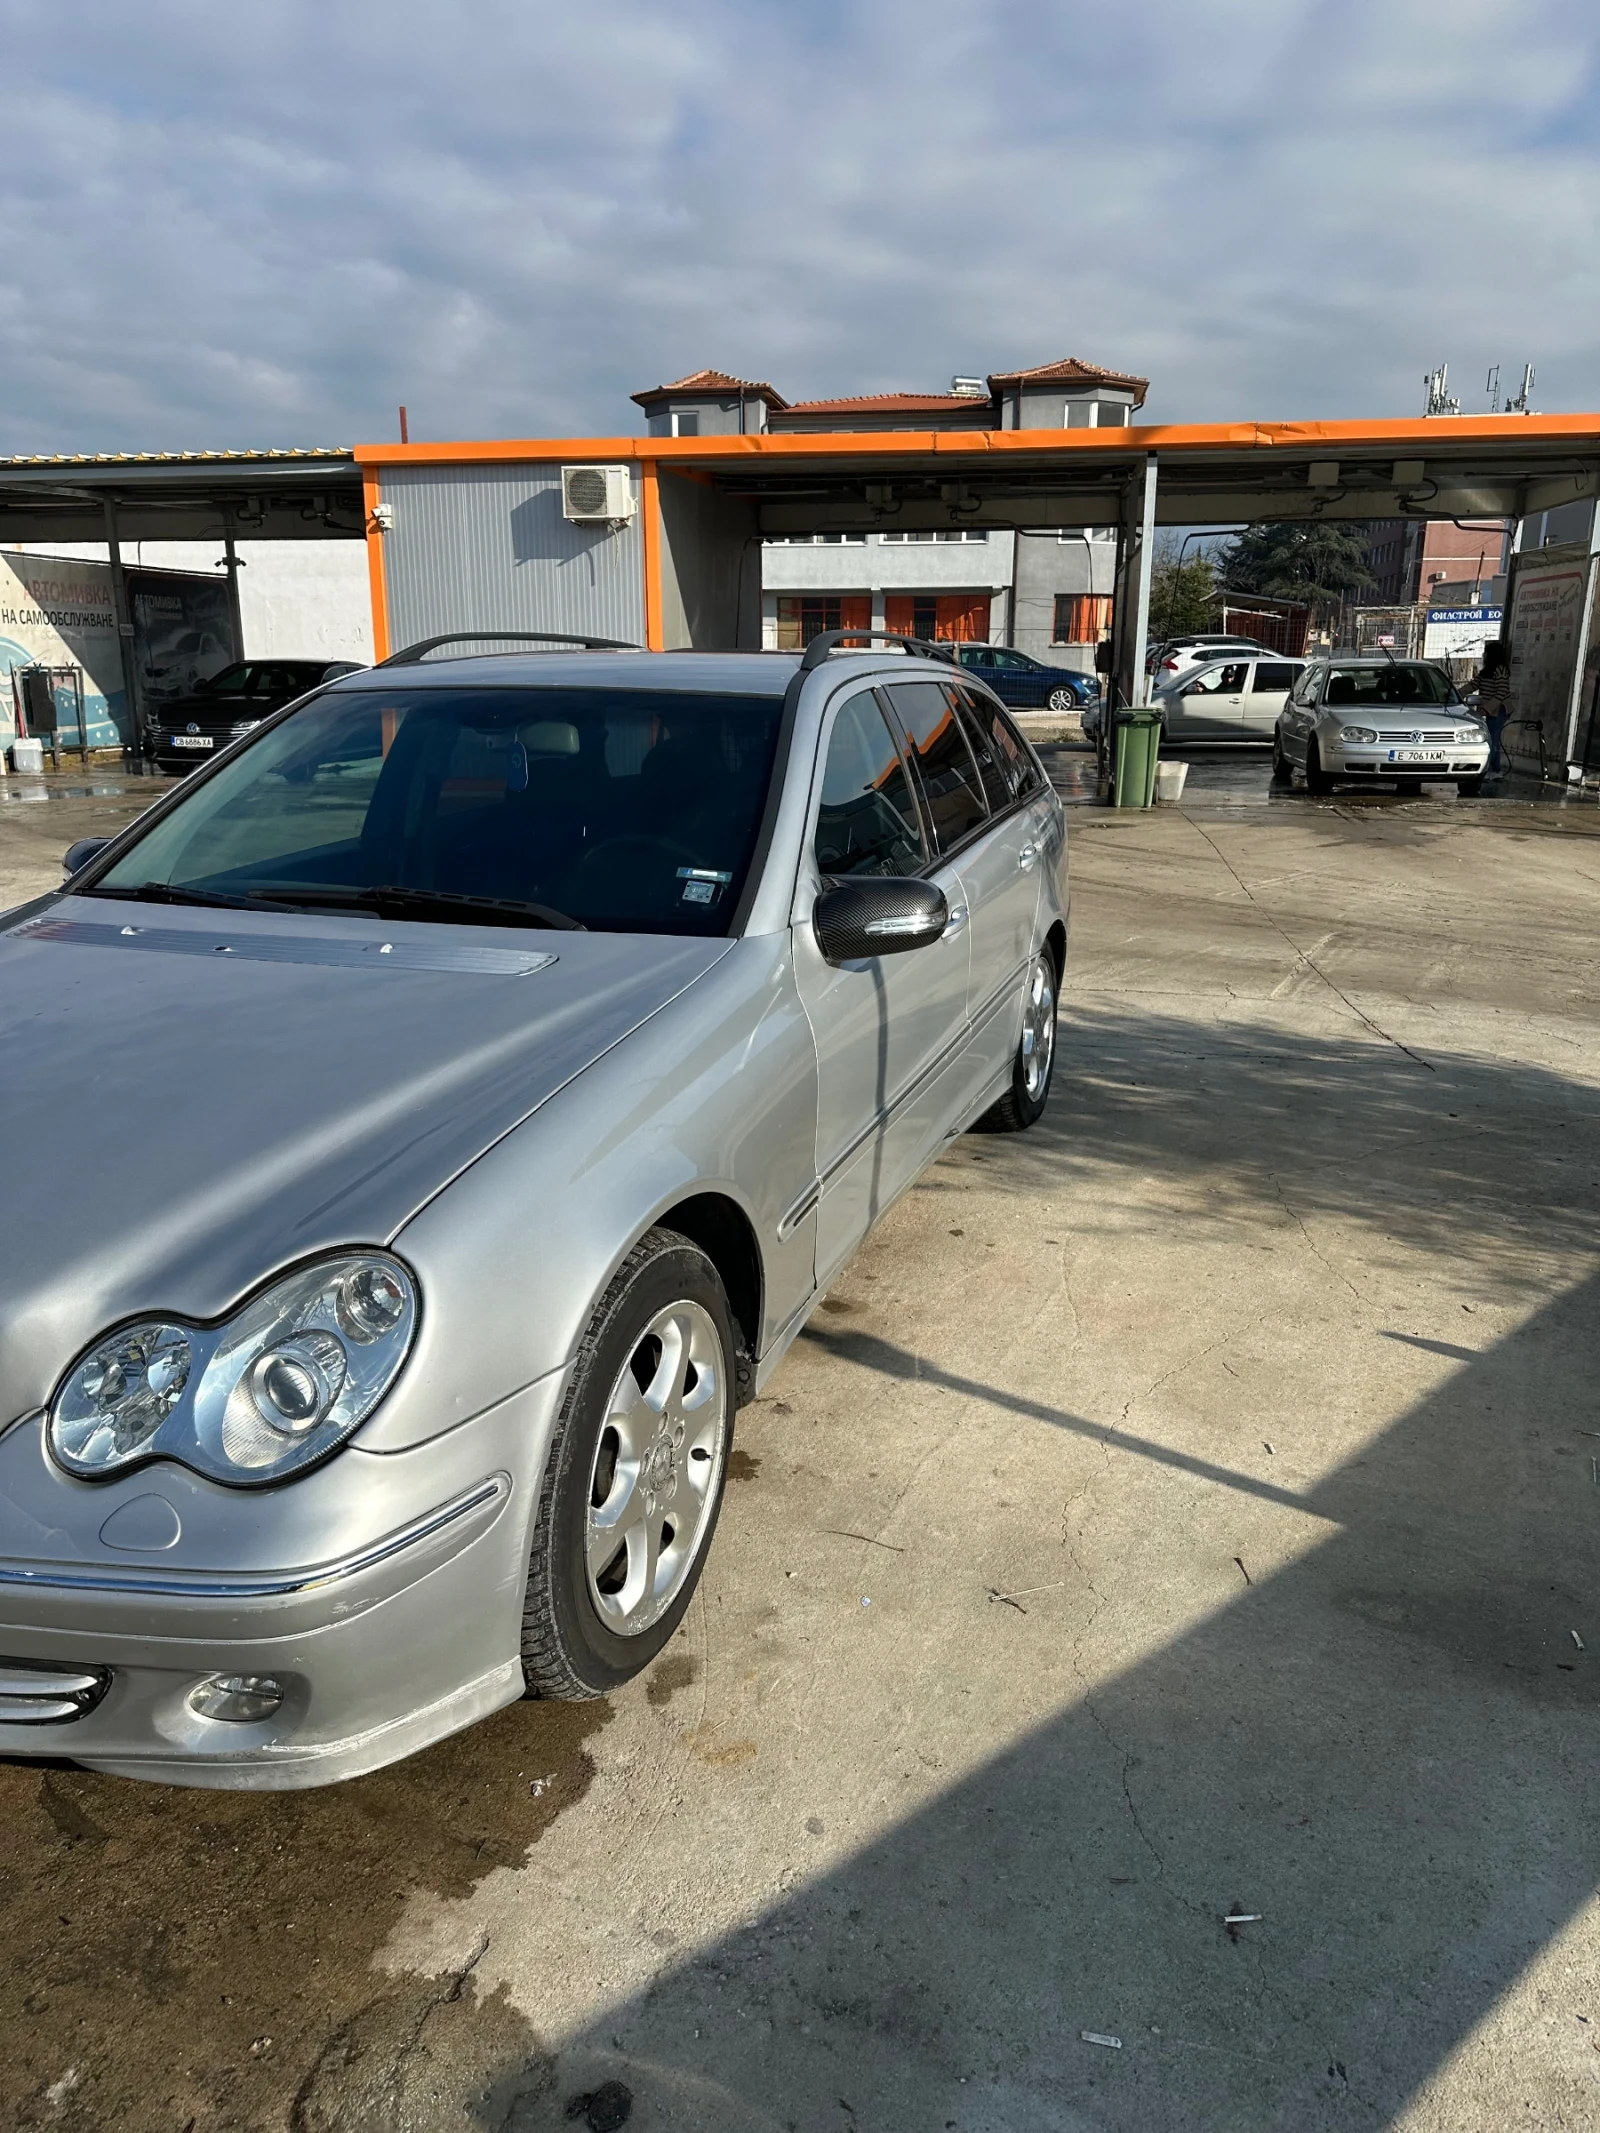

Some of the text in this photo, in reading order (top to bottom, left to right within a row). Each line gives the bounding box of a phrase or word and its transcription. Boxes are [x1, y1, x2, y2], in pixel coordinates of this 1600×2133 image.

[23, 579, 111, 605] АВТОМИВКА
[2, 608, 114, 628] НА САМООБСЛУЖВАНЕ
[1487, 610, 1503, 620] ЕО
